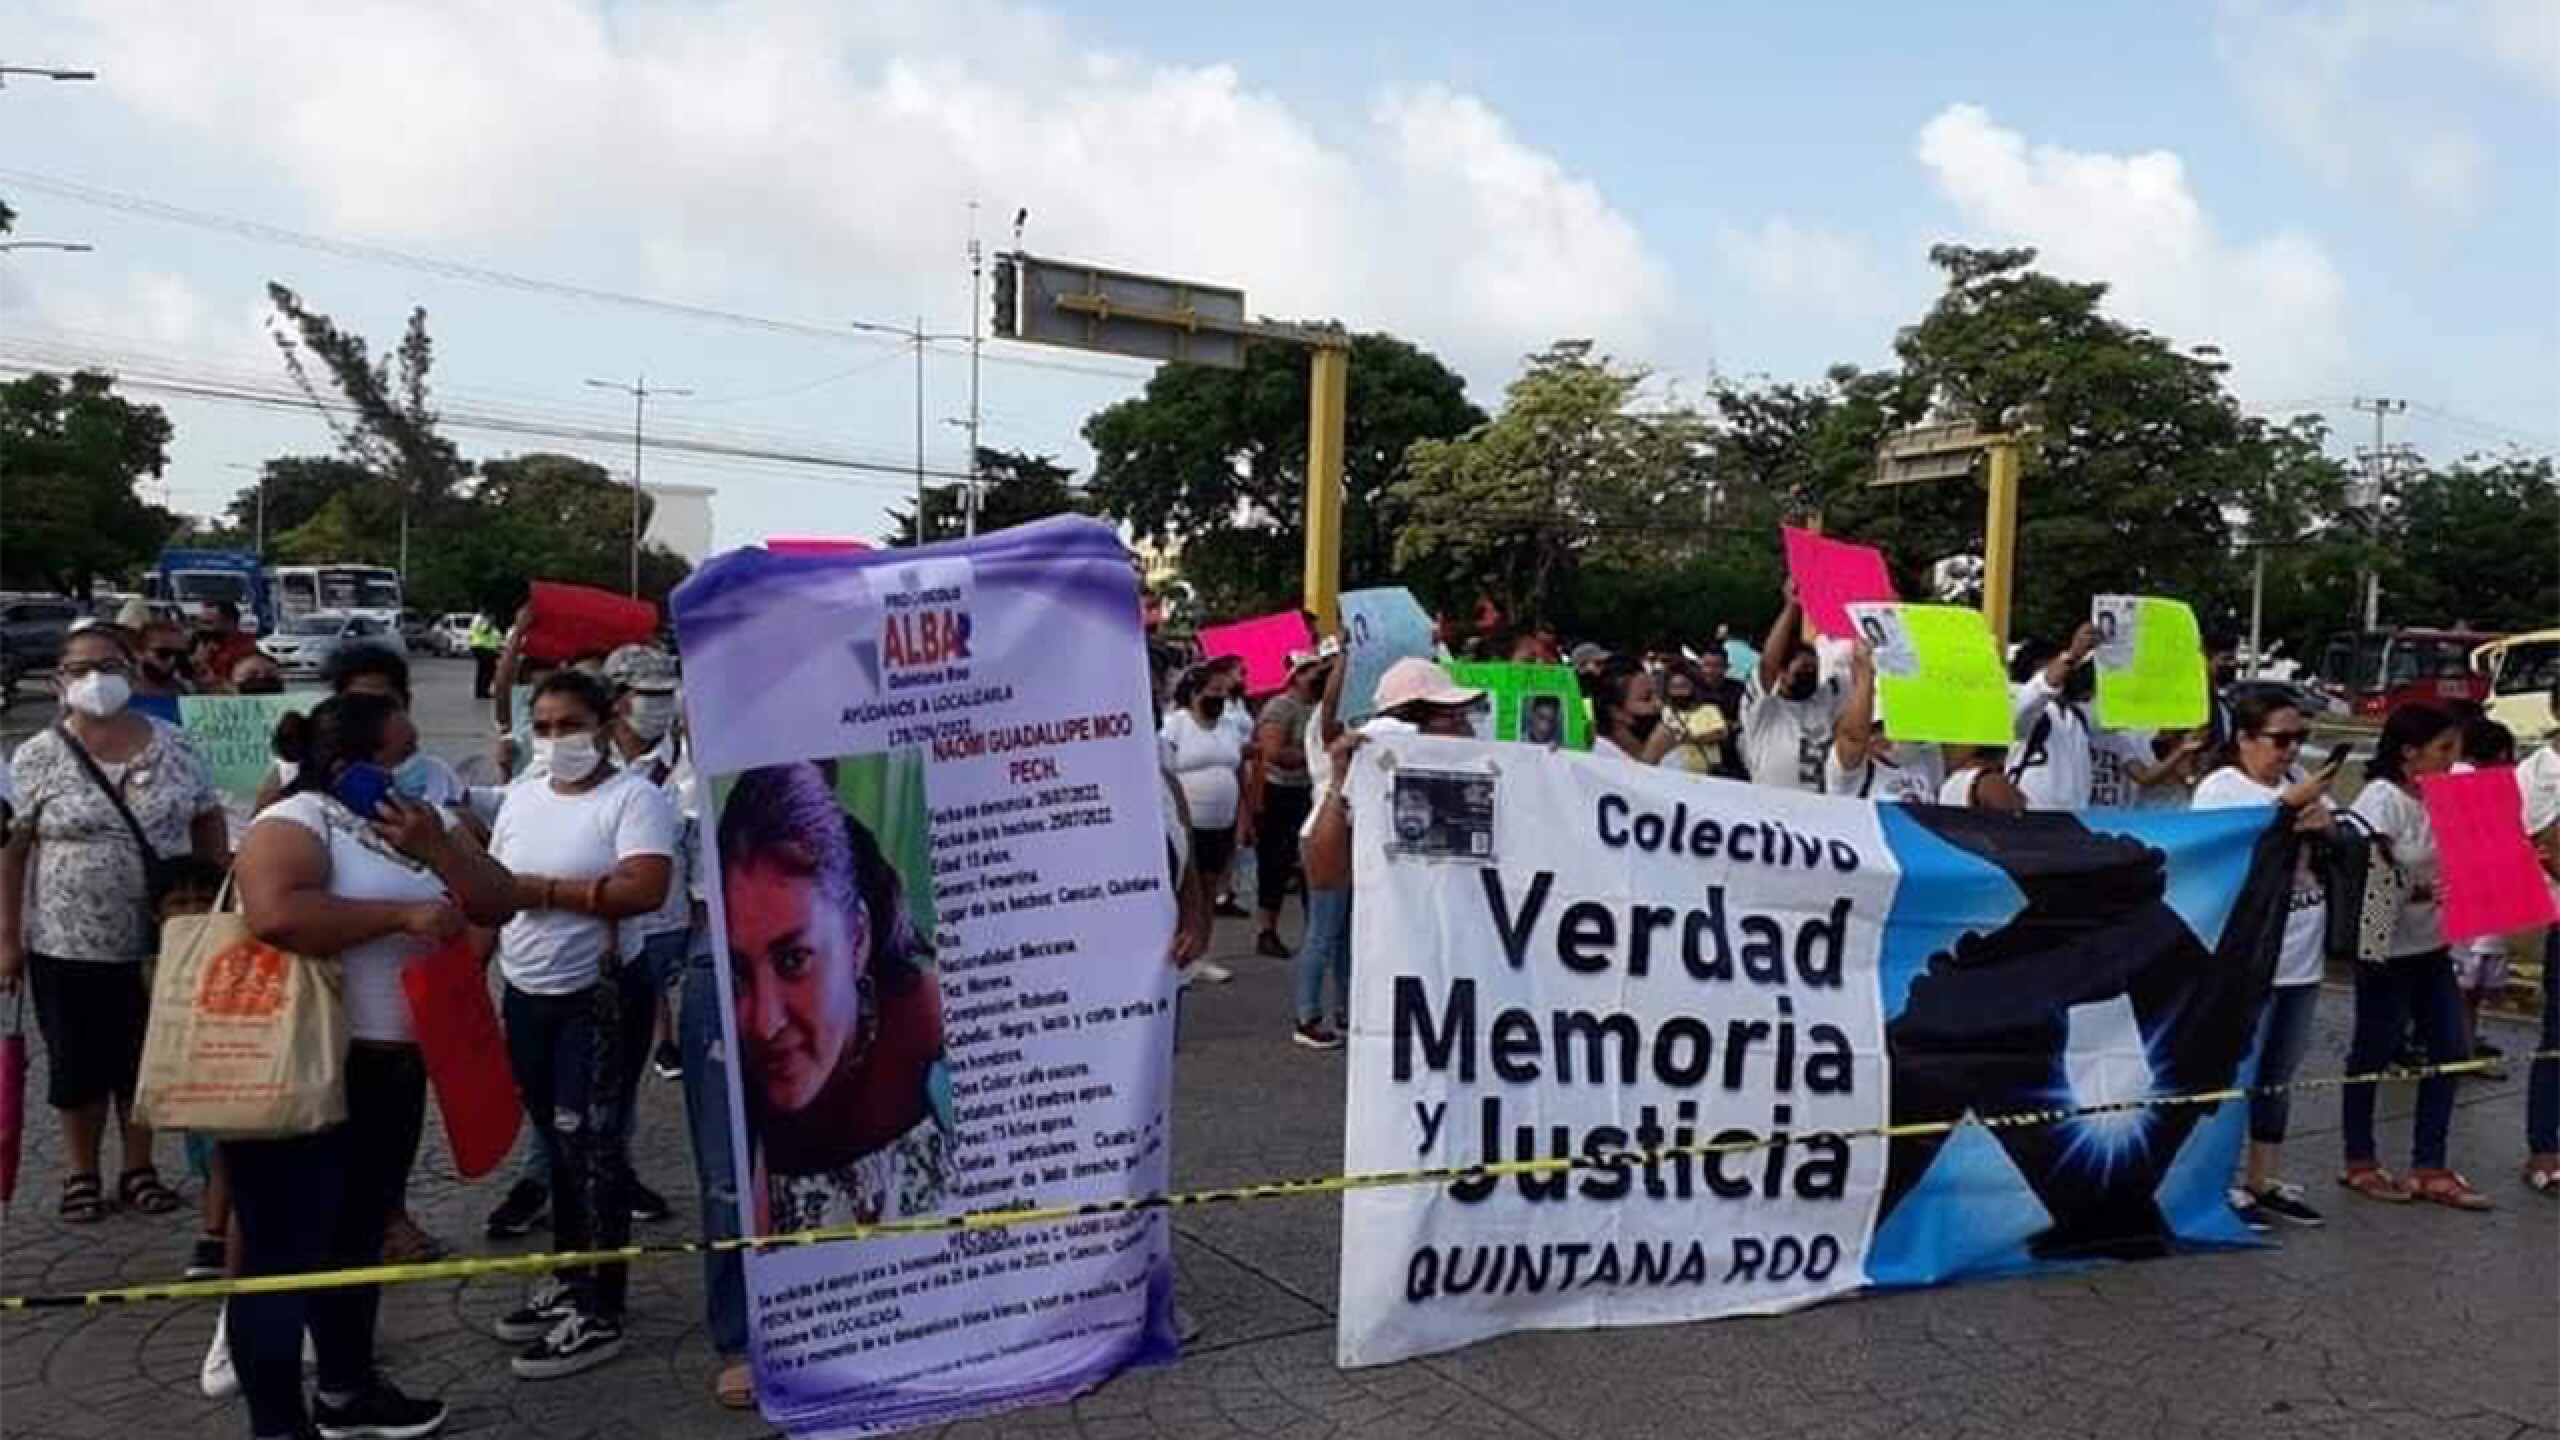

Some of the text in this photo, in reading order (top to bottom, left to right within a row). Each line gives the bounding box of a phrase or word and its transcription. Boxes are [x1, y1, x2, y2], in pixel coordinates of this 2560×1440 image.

[883, 608, 966, 669] ALBA
[920, 698, 930, 713] A
[933, 685, 1014, 713] LOCALIZARLA
[987, 716, 1090, 753] GUADALUPE
[1092, 711, 1133, 740] MOO
[1597, 794, 1861, 875] Colectivo
[1480, 867, 1854, 990] Verdad
[1074, 1012, 1081, 1031] y
[1391, 975, 1856, 1097] Memoria
[1415, 1097, 1851, 1205] y Justicia
[1405, 1238, 1707, 1303] QUINTANA
